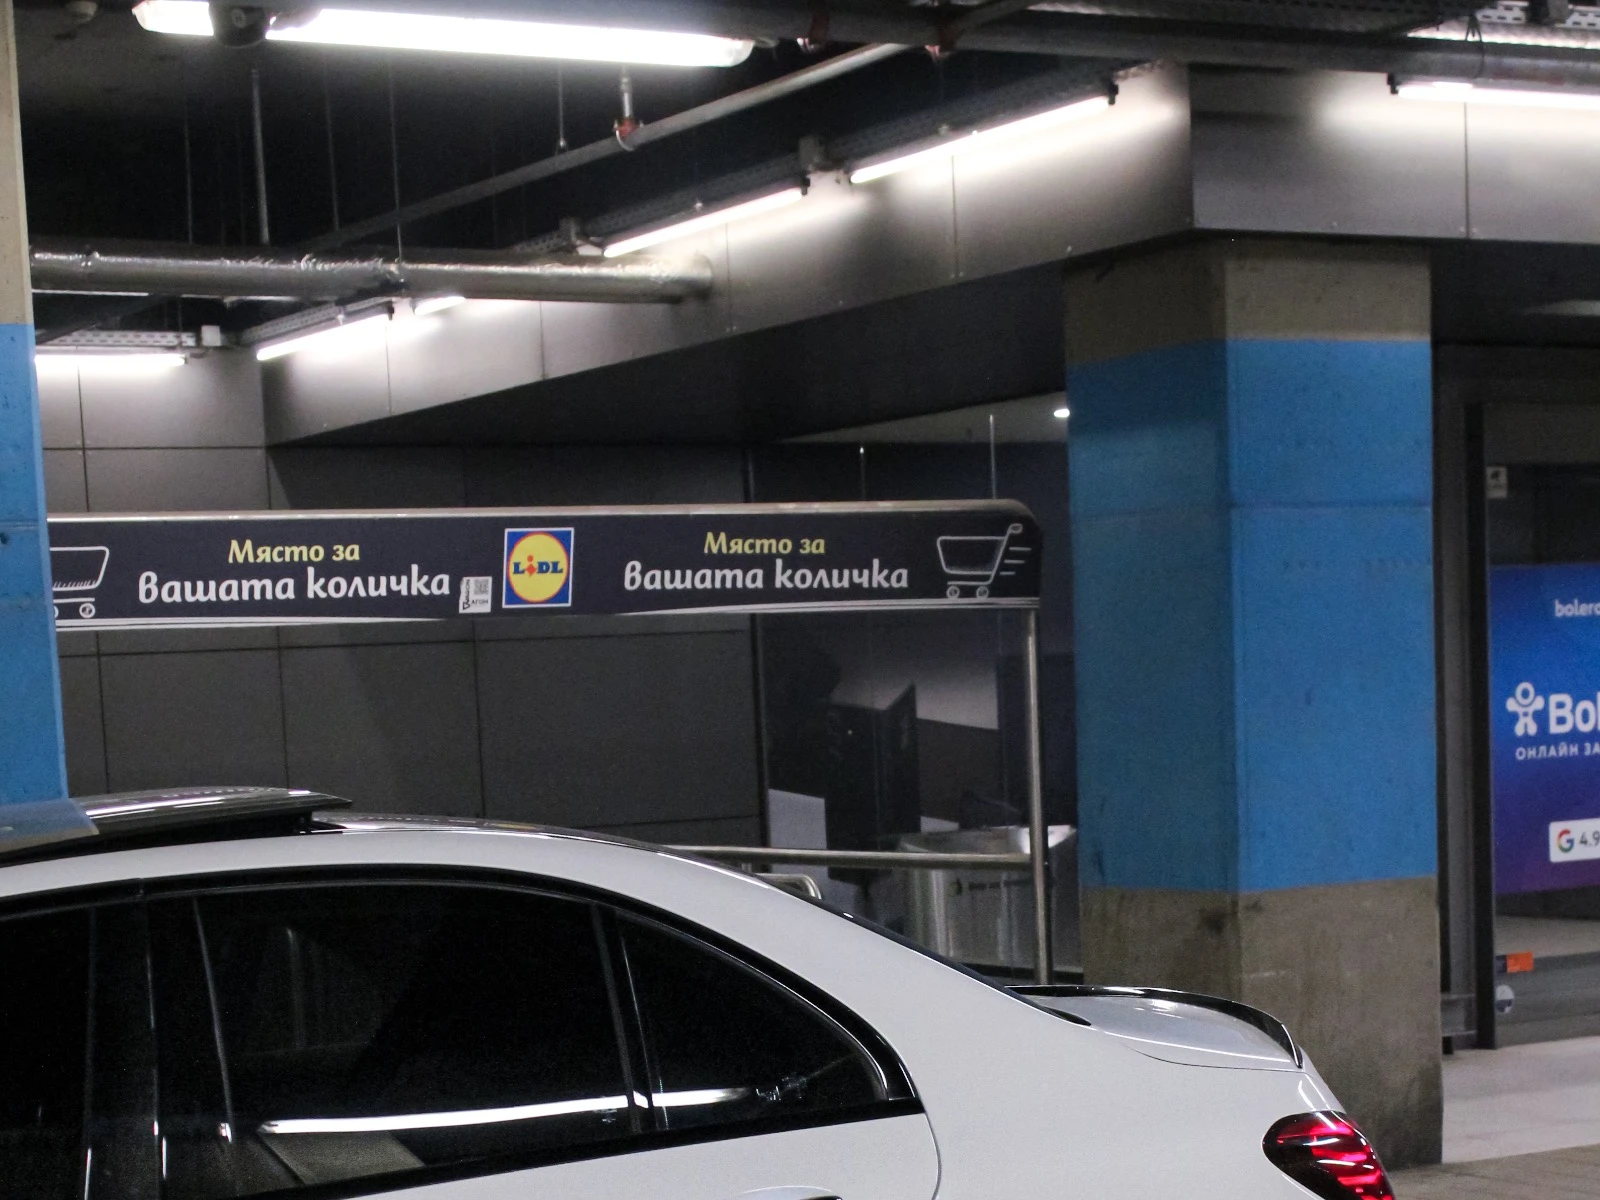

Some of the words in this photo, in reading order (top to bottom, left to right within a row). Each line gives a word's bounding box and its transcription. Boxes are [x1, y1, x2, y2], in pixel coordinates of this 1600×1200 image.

[228, 539, 325, 564] Място
[331, 544, 360, 561] за
[704, 531, 793, 554] Място
[799, 538, 826, 554] за
[138, 570, 296, 604] вашата
[307, 563, 450, 599] количка
[624, 560, 764, 591] вашата
[774, 558, 909, 589] количка
[1515, 742, 1579, 761] ОНЛАЙН
